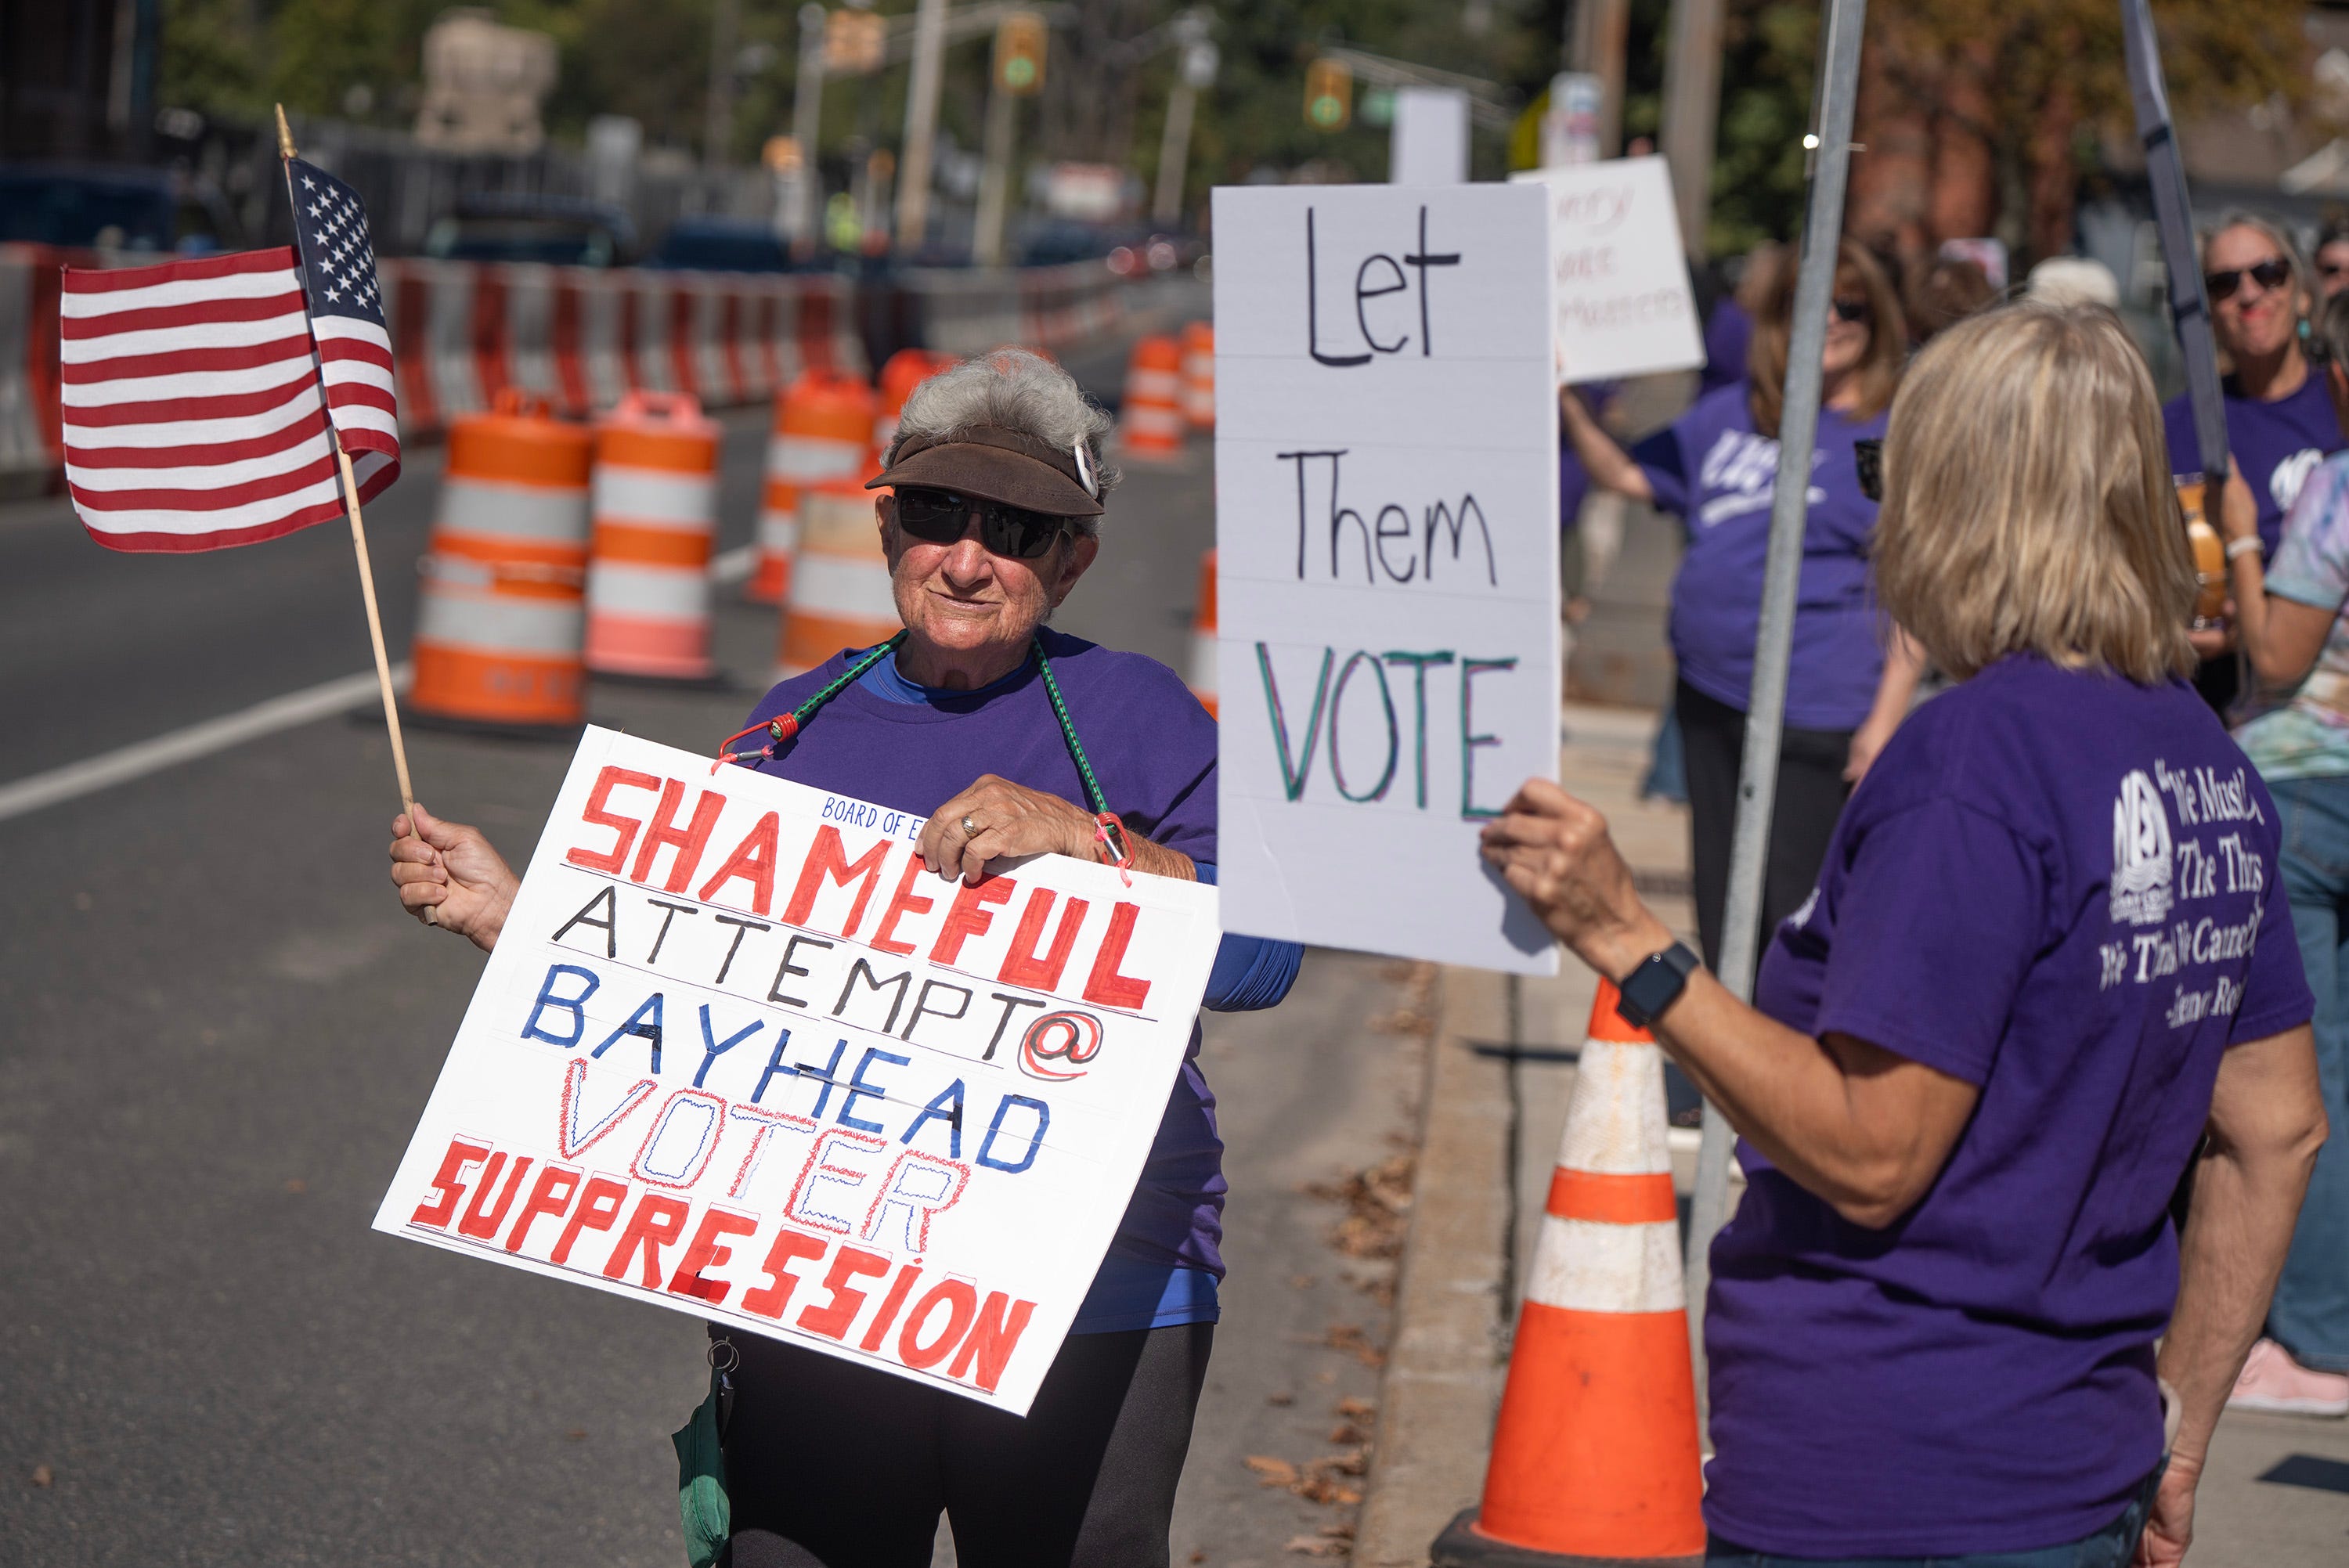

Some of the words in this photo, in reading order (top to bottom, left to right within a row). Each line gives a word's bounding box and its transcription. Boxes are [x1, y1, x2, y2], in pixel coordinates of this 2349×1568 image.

[1307, 204, 1461, 368] Let
[1276, 449, 1497, 588] Them
[821, 796, 878, 828] BOARD
[882, 812, 907, 835] OF
[1254, 640, 1520, 823] VOTE
[565, 764, 1153, 1010] SHAMEFUL
[2176, 834, 2218, 900] The
[520, 963, 1051, 1174] BAYHEAD
[558, 1057, 972, 1253] VOTER
